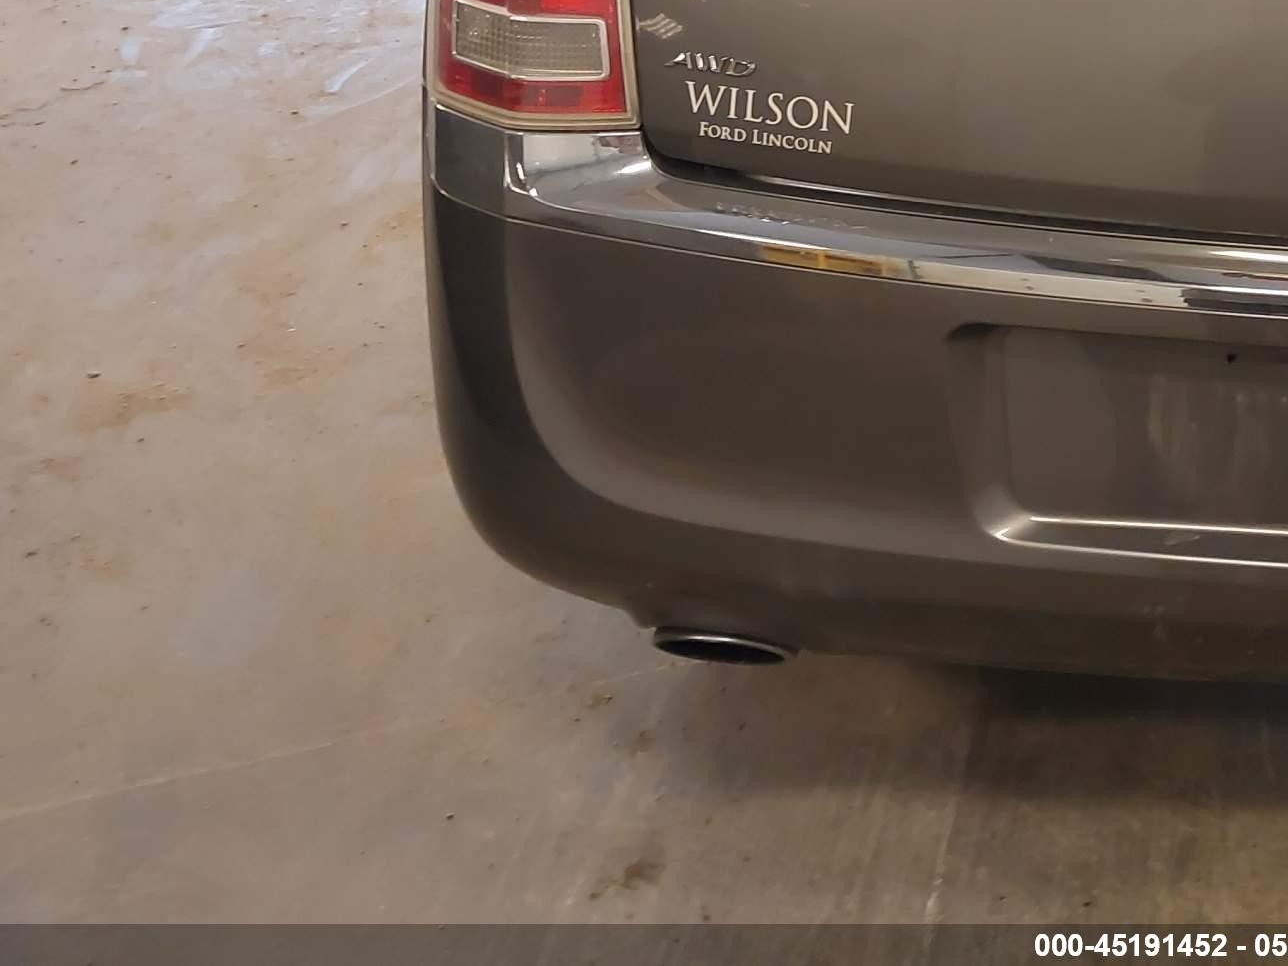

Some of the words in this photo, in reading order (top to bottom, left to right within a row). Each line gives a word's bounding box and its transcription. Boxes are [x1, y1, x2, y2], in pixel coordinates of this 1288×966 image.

[664, 50, 759, 77] AWD
[684, 80, 855, 135] WILSON
[698, 121, 747, 142] FORD
[752, 129, 833, 154] LINCOLN
